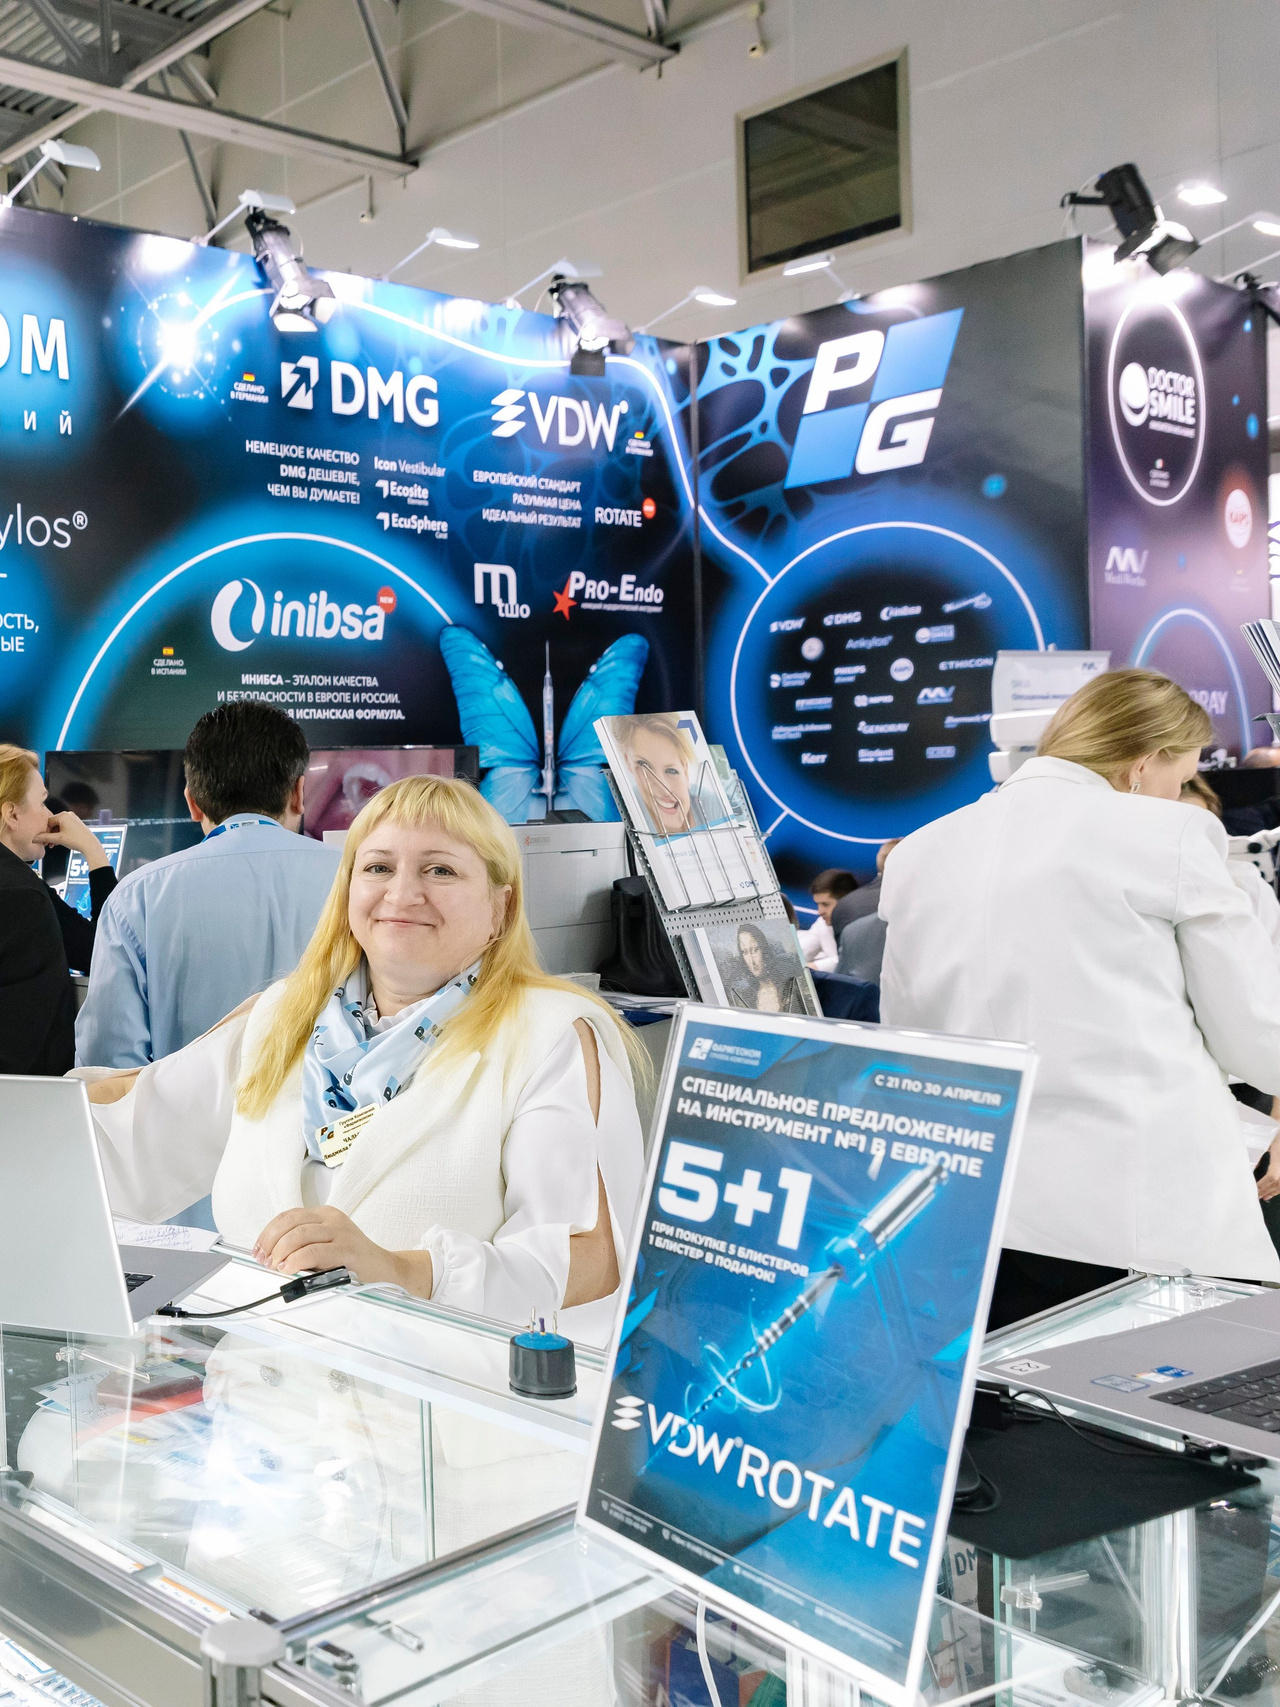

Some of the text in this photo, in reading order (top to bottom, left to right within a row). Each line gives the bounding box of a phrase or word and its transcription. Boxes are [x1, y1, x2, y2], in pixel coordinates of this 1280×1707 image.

[331, 360, 439, 427] DMG
[1149, 390, 1196, 425] SMILE
[246, 440, 360, 465] НЕМЕЦКОЕ КАЧЕСТВО
[280, 465, 360, 486] DMG ДЕШЕВЛЕ,
[374, 456, 446, 477] Icon Vestibular
[390, 481, 429, 499] Ecosite
[473, 470, 581, 493] ЕВРОПЕЙСКИЙ СТАНДАРТ
[268, 484, 360, 504] ЧЕМ ВЫ ДУМАЕТЕ!
[513, 493, 582, 511] РАЗУМНАЯ ЦЕНА
[392, 513, 448, 534] EcuSphere
[482, 508, 582, 528] ИДЕАЛЬНЫЙ РЕЗУЛЬТАТ
[595, 507, 642, 527] ROTATE
[271, 590, 386, 640] inibsa
[153, 659, 184, 667] СДЕЛАНО
[241, 674, 283, 686] ИНИБСА
[292, 675, 332, 686] ЭТАЛОН
[332, 676, 379, 687] КАЧЕСТВА
[217, 691, 401, 704] И БЕЗОПАСНОСТИ В ЕВРОПЕ И РОССИИ.
[296, 709, 354, 720] ИСПАНСКАЯ
[355, 709, 405, 720] ФОРМУЛА.
[801, 752, 828, 764] Kerr
[70, 859, 90, 876] 5+
[874, 1074, 1002, 1106] С 21 ПО 30 АПРЕЛЯ
[682, 1075, 996, 1153] СПЕЦИАЛЬНОЕ ПРЕДЛОЖЕНИЕ
[677, 1098, 984, 1179] НА ИНСТРУМЕНТ №1 В ЕВРОПЕ
[658, 1140, 813, 1251] 5+1
[649, 1234, 776, 1284] 1 БЛИСТЕР В ПОДАРОК!
[651, 1220, 809, 1277] ПРИ ПОКУПКЕ 5 БЛИСТЕРОВ
[736, 1444, 926, 1569] ROTATE
